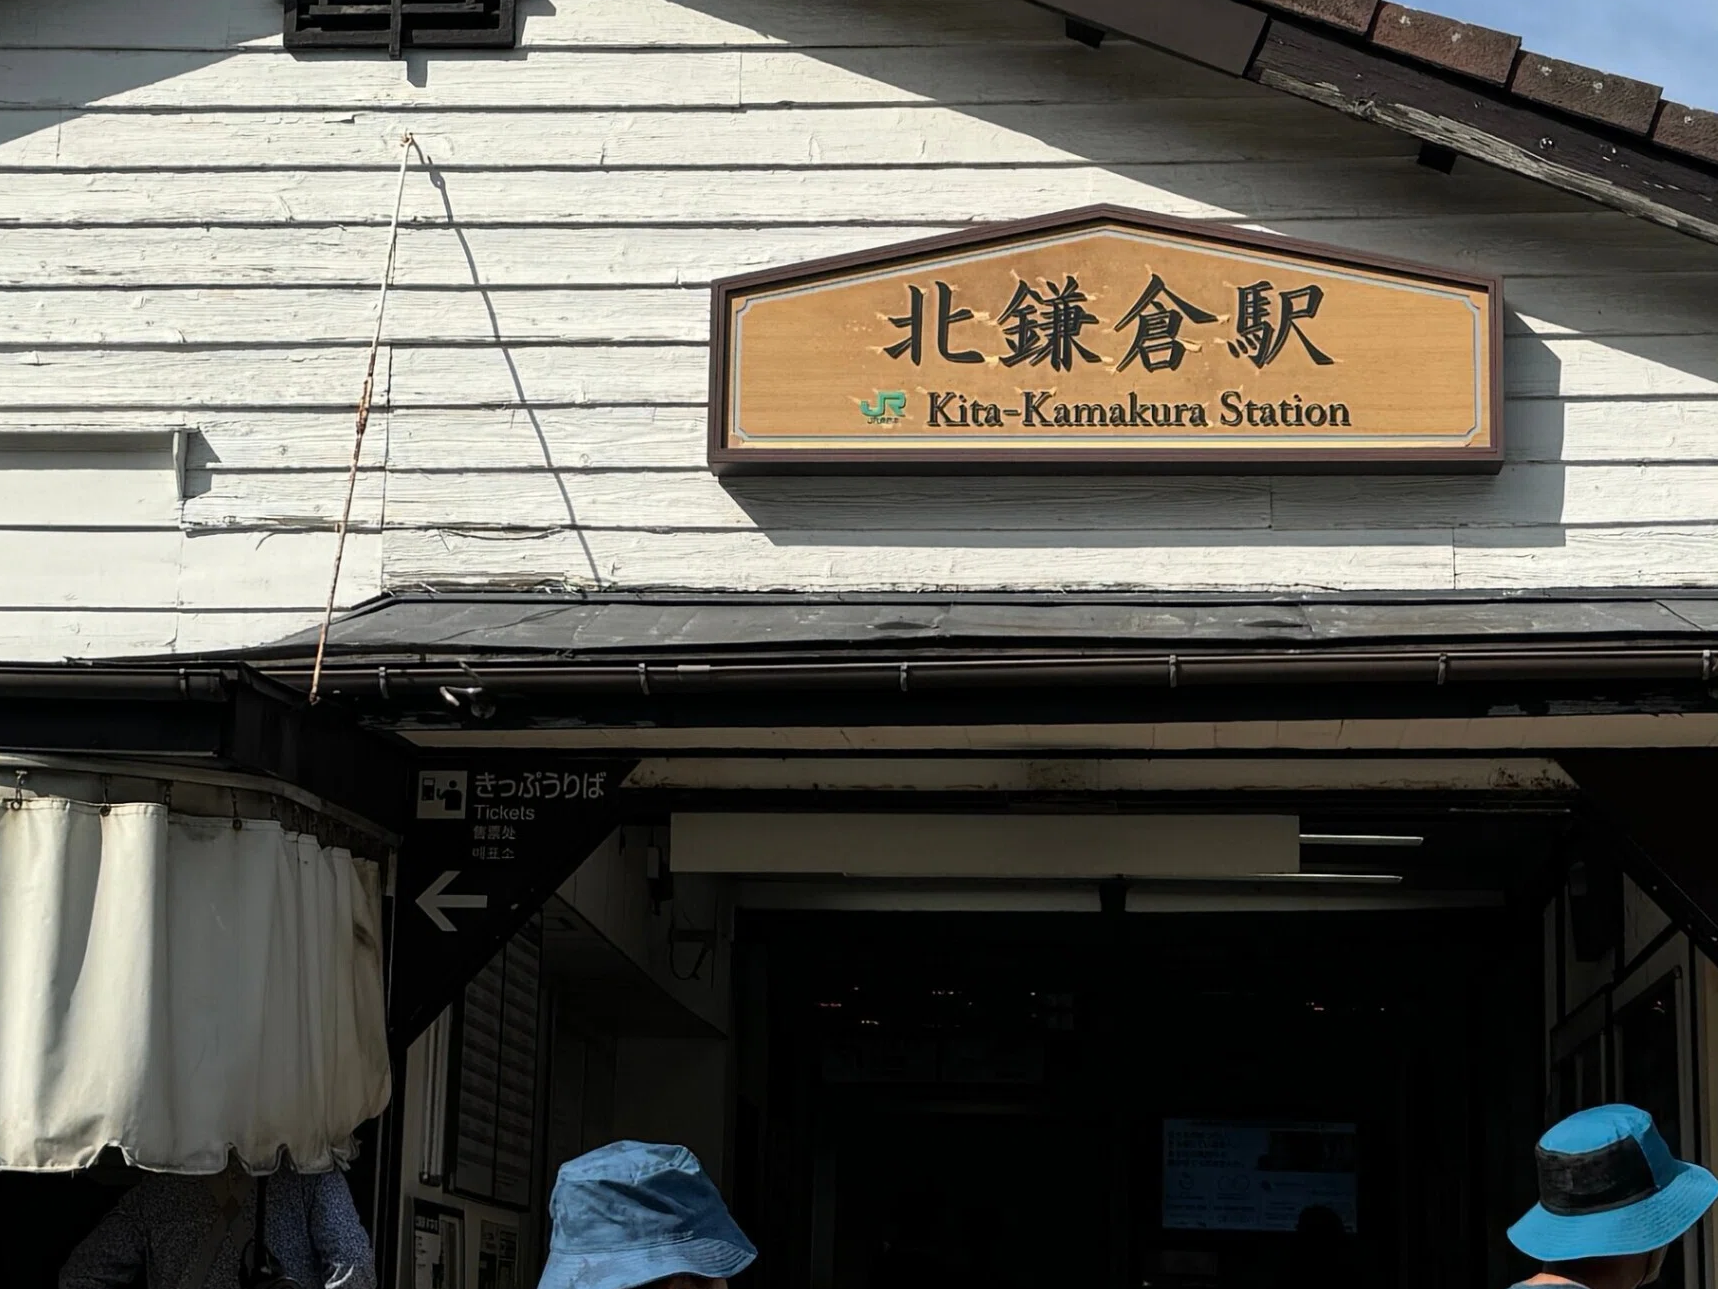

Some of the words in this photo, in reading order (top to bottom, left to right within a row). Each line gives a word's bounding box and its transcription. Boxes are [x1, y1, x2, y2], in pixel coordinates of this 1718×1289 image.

[882, 272, 1336, 373] 北鎌倉駅
[860, 391, 907, 418] JR
[926, 390, 1213, 428] Kita-Kamakura
[1219, 390, 1352, 427] Station
[474, 770, 608, 800] きっぷうりば
[473, 804, 536, 821] Tickets
